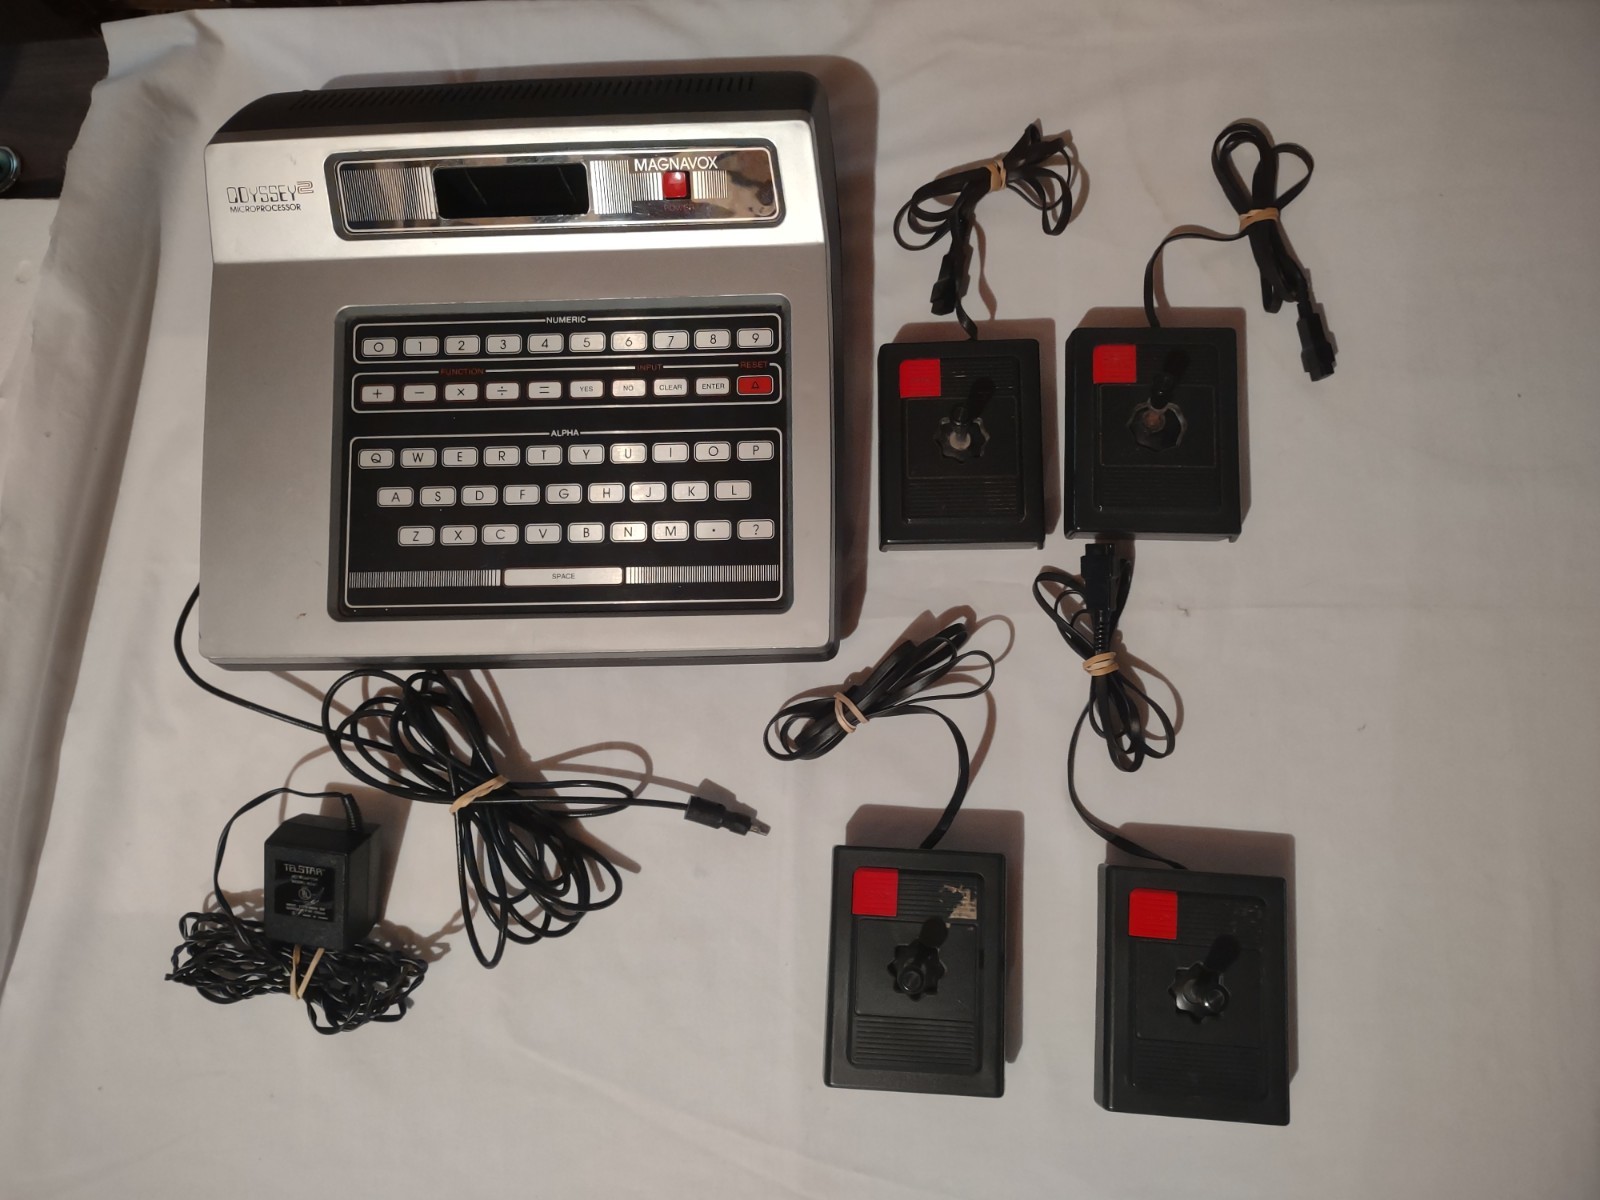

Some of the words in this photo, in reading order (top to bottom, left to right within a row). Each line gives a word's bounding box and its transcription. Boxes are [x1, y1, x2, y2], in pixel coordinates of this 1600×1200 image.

[634, 156, 718, 171] MAGNAVOX
[230, 203, 301, 213] MICROPROCESSOR
[546, 315, 586, 324] NUMERIC
[457, 340, 465, 351] 2
[500, 339, 507, 350] 3
[541, 338, 549, 349] 4
[583, 337, 591, 348] 5
[625, 336, 633, 347] 6
[668, 335, 675, 347] 7
[709, 333, 717, 345] 8
[751, 332, 760, 344] 9
[637, 363, 663, 371] INPUT
[740, 360, 768, 369] RESET
[440, 367, 484, 376] FUNCTION
[579, 385, 594, 393] YES
[550, 428, 580, 437] ALPHA
[370, 452, 382, 464] Q
[412, 452, 424, 463] W
[457, 451, 463, 462] E
[498, 450, 506, 461] R
[541, 449, 547, 461] T
[582, 449, 590, 460] Y
[624, 448, 632, 459] U
[708, 445, 719, 457] O
[752, 444, 760, 456] P
[391, 491, 401, 503] A
[434, 490, 442, 502] S
[475, 490, 485, 501] D
[519, 489, 526, 500] F
[558, 488, 570, 500] G
[602, 487, 611, 499] H
[645, 486, 652, 498] J
[688, 486, 696, 497] K
[731, 485, 737, 496] L
[412, 530, 420, 542] Z
[454, 530, 463, 541] X
[495, 528, 506, 540] C
[538, 528, 548, 539] V
[583, 527, 590, 538] B
[623, 526, 633, 537] N
[665, 525, 677, 537] M
[752, 523, 760, 536] ?
[283, 863, 323, 876] TELSTAR
